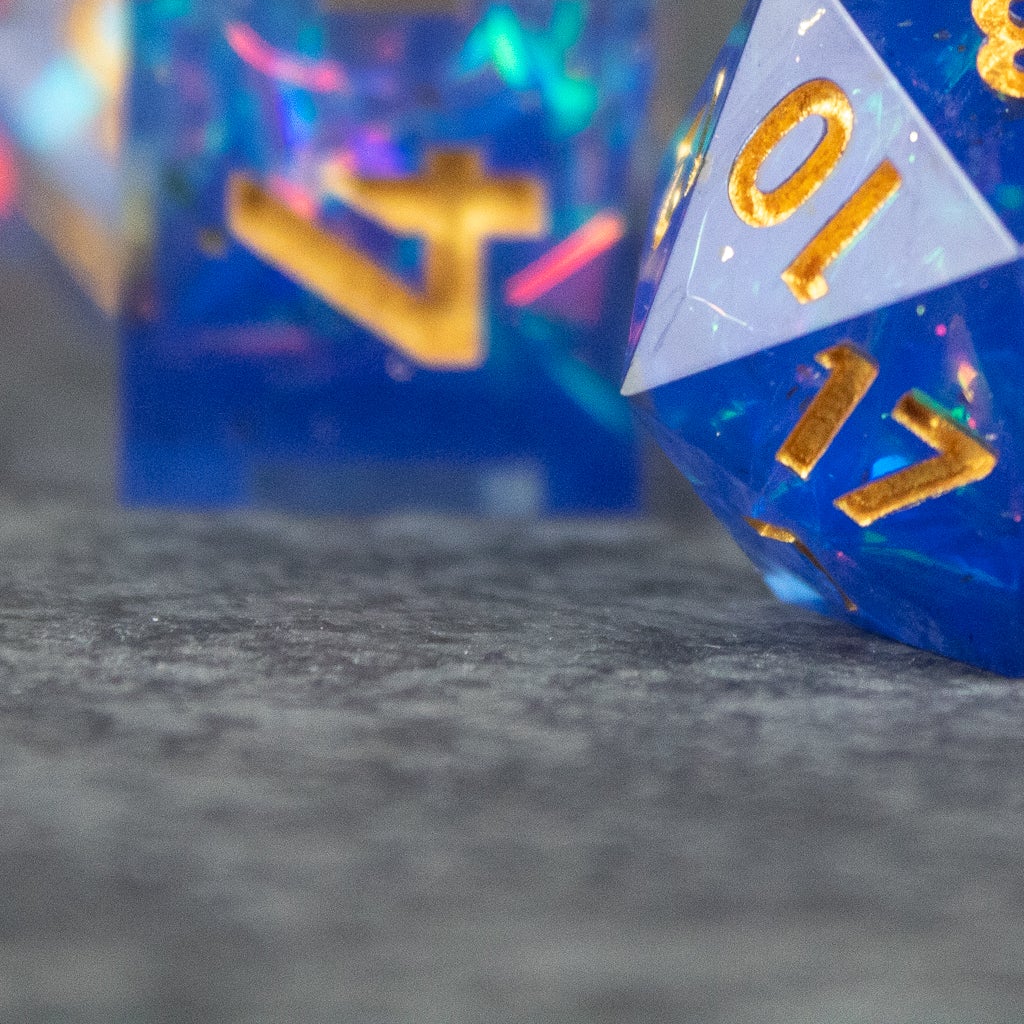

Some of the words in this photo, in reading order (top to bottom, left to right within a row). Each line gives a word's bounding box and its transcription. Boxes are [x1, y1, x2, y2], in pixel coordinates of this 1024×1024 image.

[228, 151, 548, 367] 4
[727, 79, 904, 306] 10
[776, 344, 998, 527] 17
